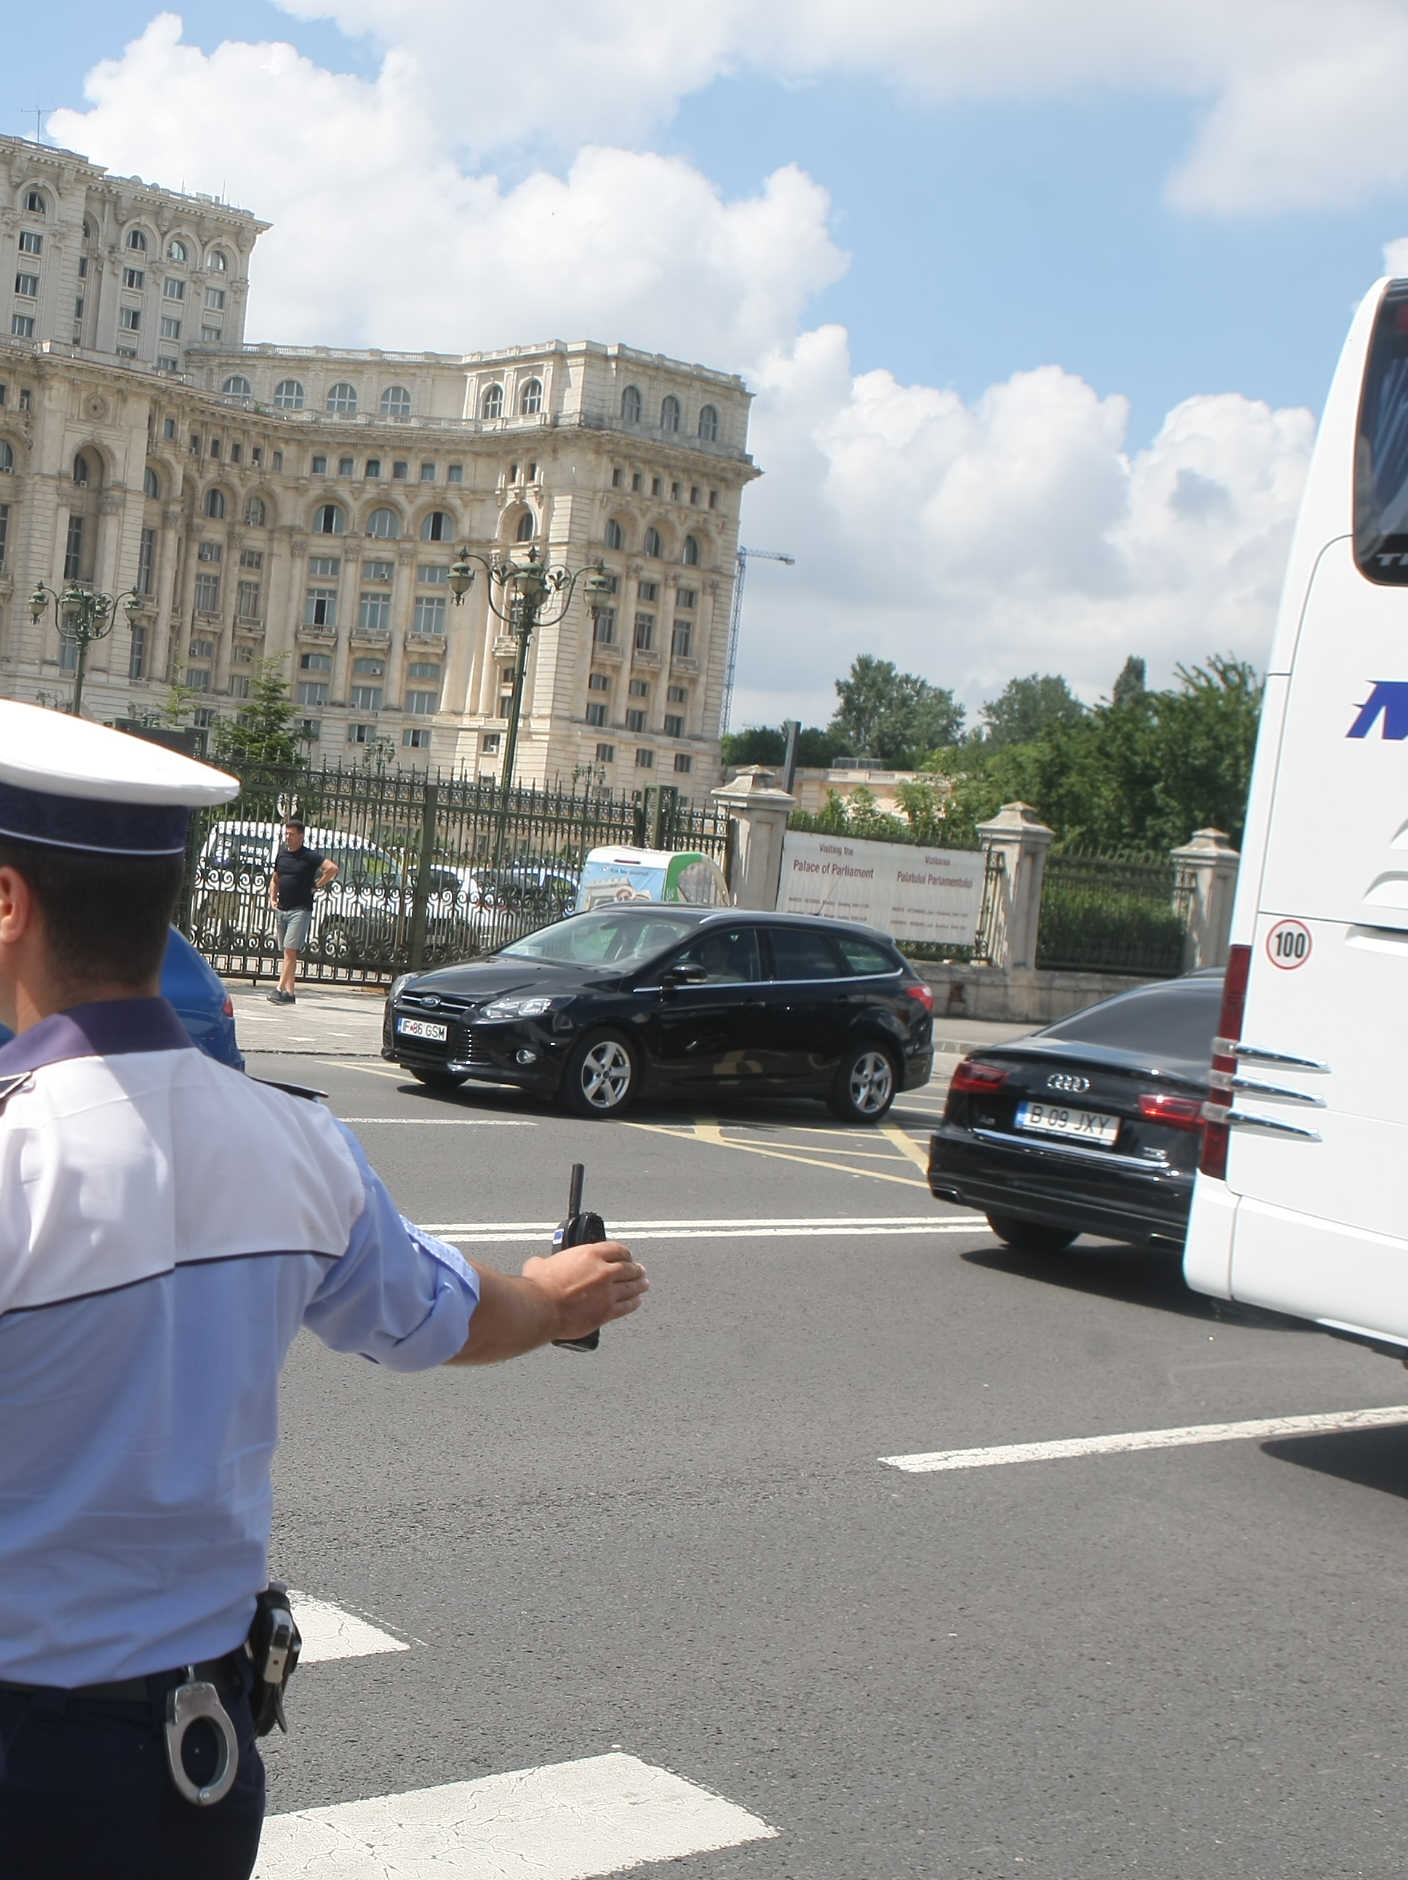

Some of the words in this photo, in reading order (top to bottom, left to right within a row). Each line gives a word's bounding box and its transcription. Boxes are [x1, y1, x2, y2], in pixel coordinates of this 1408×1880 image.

[819, 843, 843, 857] Visiting
[843, 846, 854, 857] the
[793, 859, 821, 874] Palace
[821, 863, 831, 875] of
[831, 863, 874, 880] Parliament
[896, 870, 927, 885] Palatului
[927, 873, 974, 889] Parlamentului
[1275, 931, 1307, 959] 100
[425, 1025, 445, 1039] GSM
[1030, 1104, 1044, 1125] B
[1048, 1108, 1070, 1129] 09
[1073, 1112, 1111, 1136] JXY
